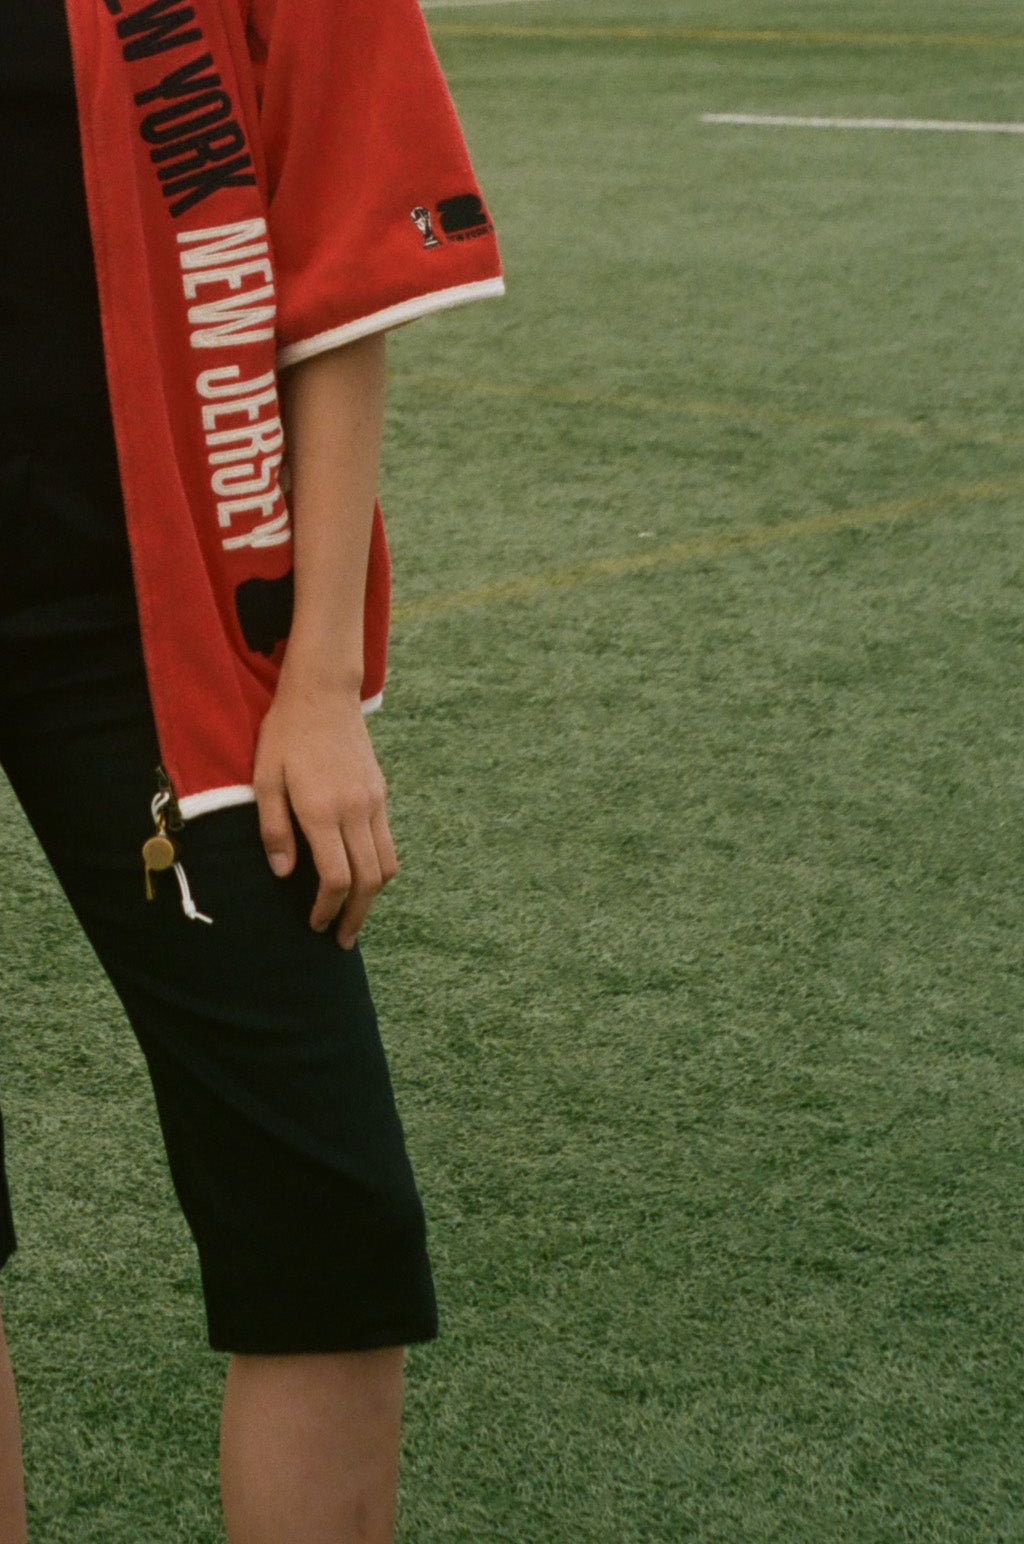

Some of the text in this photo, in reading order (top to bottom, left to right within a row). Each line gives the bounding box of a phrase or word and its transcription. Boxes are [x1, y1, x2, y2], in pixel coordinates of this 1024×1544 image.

[134, 52, 256, 219] YORK
[177, 217, 276, 348] NEW
[195, 365, 292, 550] JERSEY
